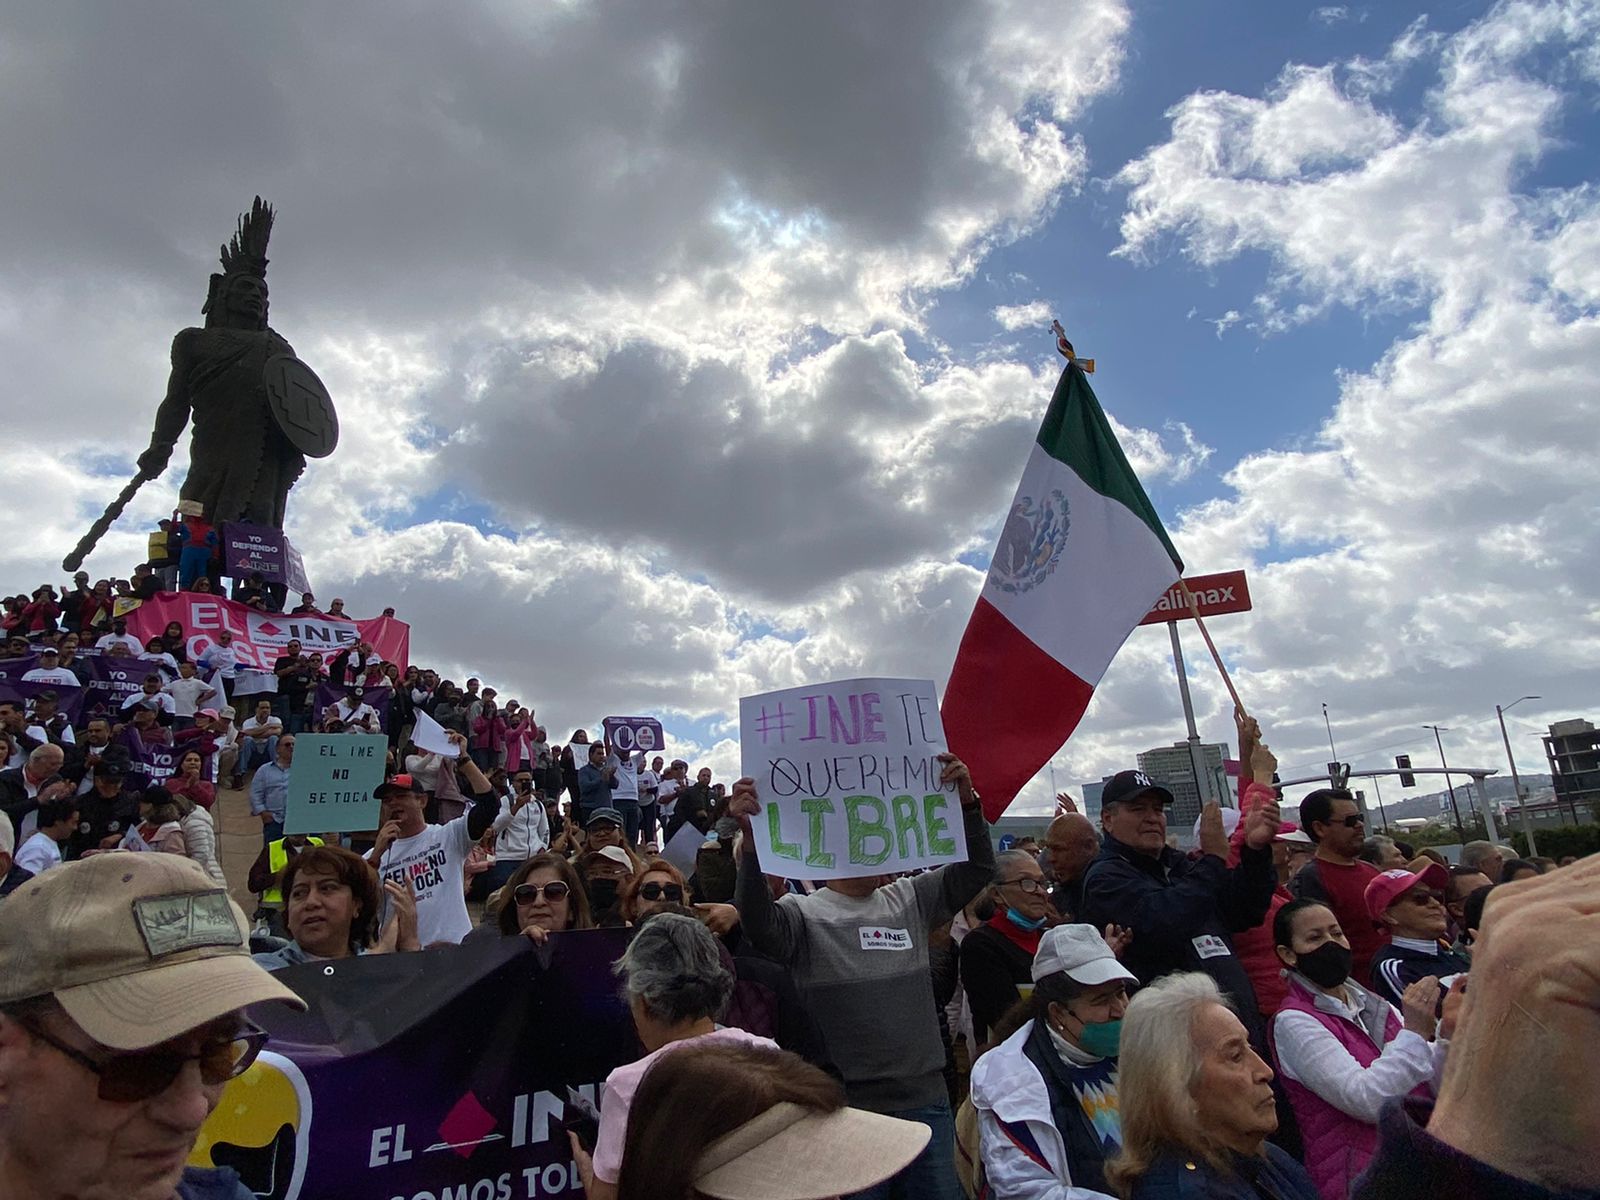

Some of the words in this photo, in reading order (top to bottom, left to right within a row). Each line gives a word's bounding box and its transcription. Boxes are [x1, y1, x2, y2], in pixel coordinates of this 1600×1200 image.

[248, 535, 262, 543] YO
[250, 561, 280, 573] INE
[1151, 586, 1237, 613] alimax
[191, 602, 243, 636] EL
[289, 624, 355, 644] INE
[108, 670, 127, 680] YO
[109, 692, 125, 701] AL
[755, 692, 888, 745] #INE
[896, 693, 937, 746] TE
[319, 745, 337, 757] EL
[350, 746, 375, 757] INE
[152, 752, 173, 765] YO
[129, 760, 177, 776] DEFIEN
[332, 768, 350, 780] NO
[1134, 772, 1151, 786] NY
[308, 792, 328, 804] SE
[333, 791, 368, 803] TOCA
[766, 794, 957, 868] LIBRE
[884, 932, 907, 942] INE
[369, 1124, 413, 1168] EL
[511, 1082, 604, 1148] IN
